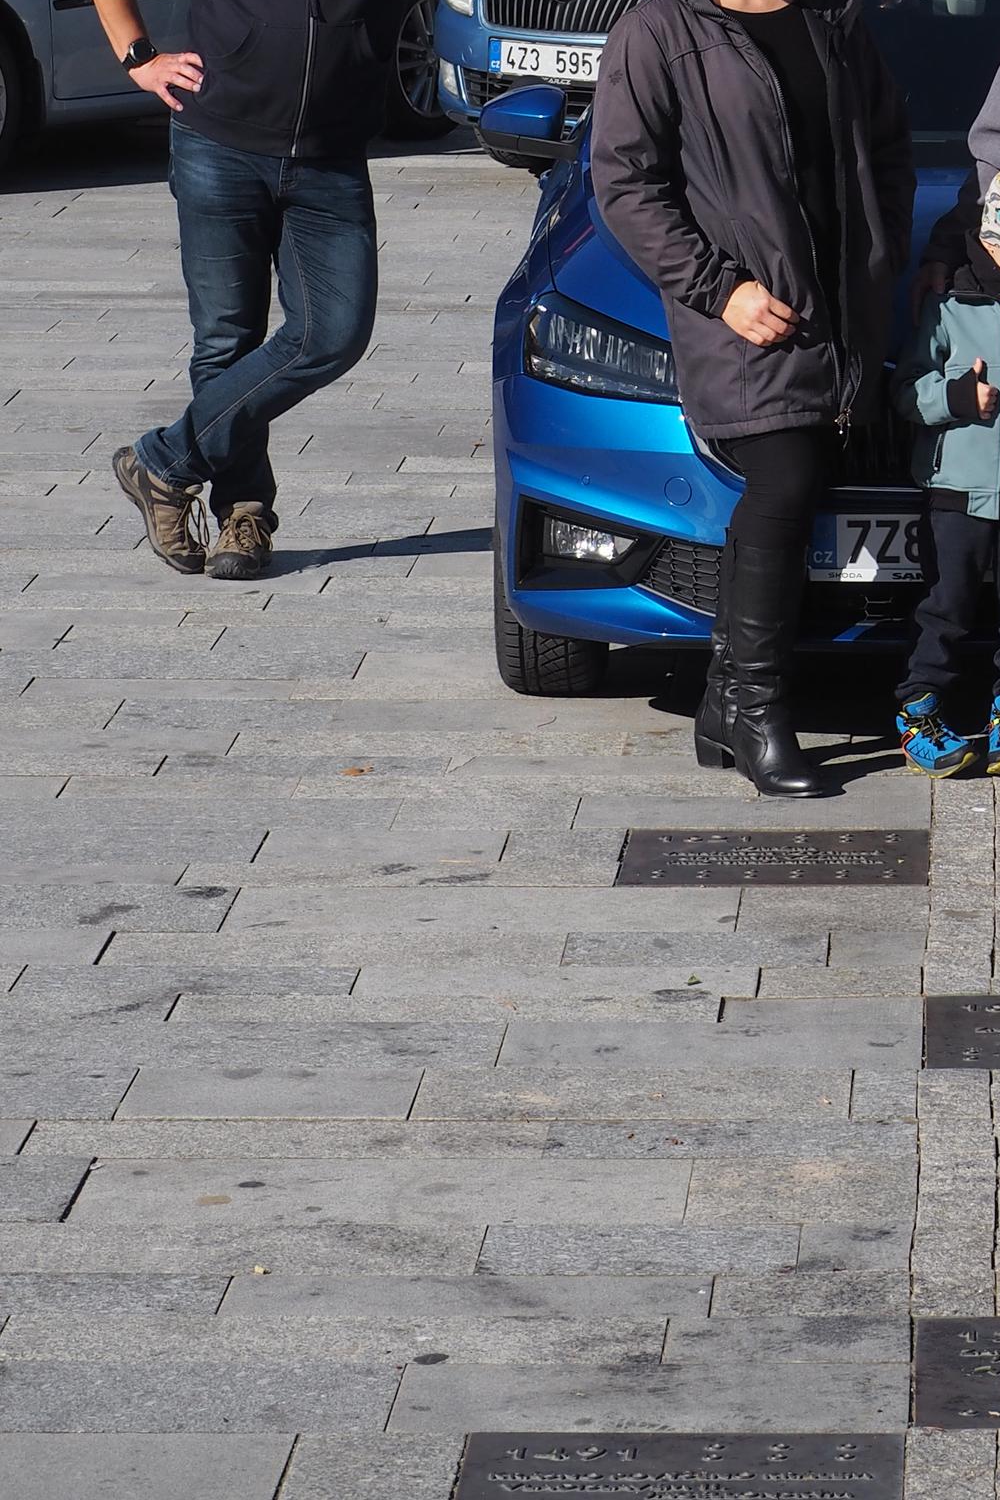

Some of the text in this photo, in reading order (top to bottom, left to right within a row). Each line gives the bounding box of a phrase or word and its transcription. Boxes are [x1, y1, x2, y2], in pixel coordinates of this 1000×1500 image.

[491, 45, 602, 76] CZ 4Z3 595
[813, 520, 920, 563] CZ 7Z8
